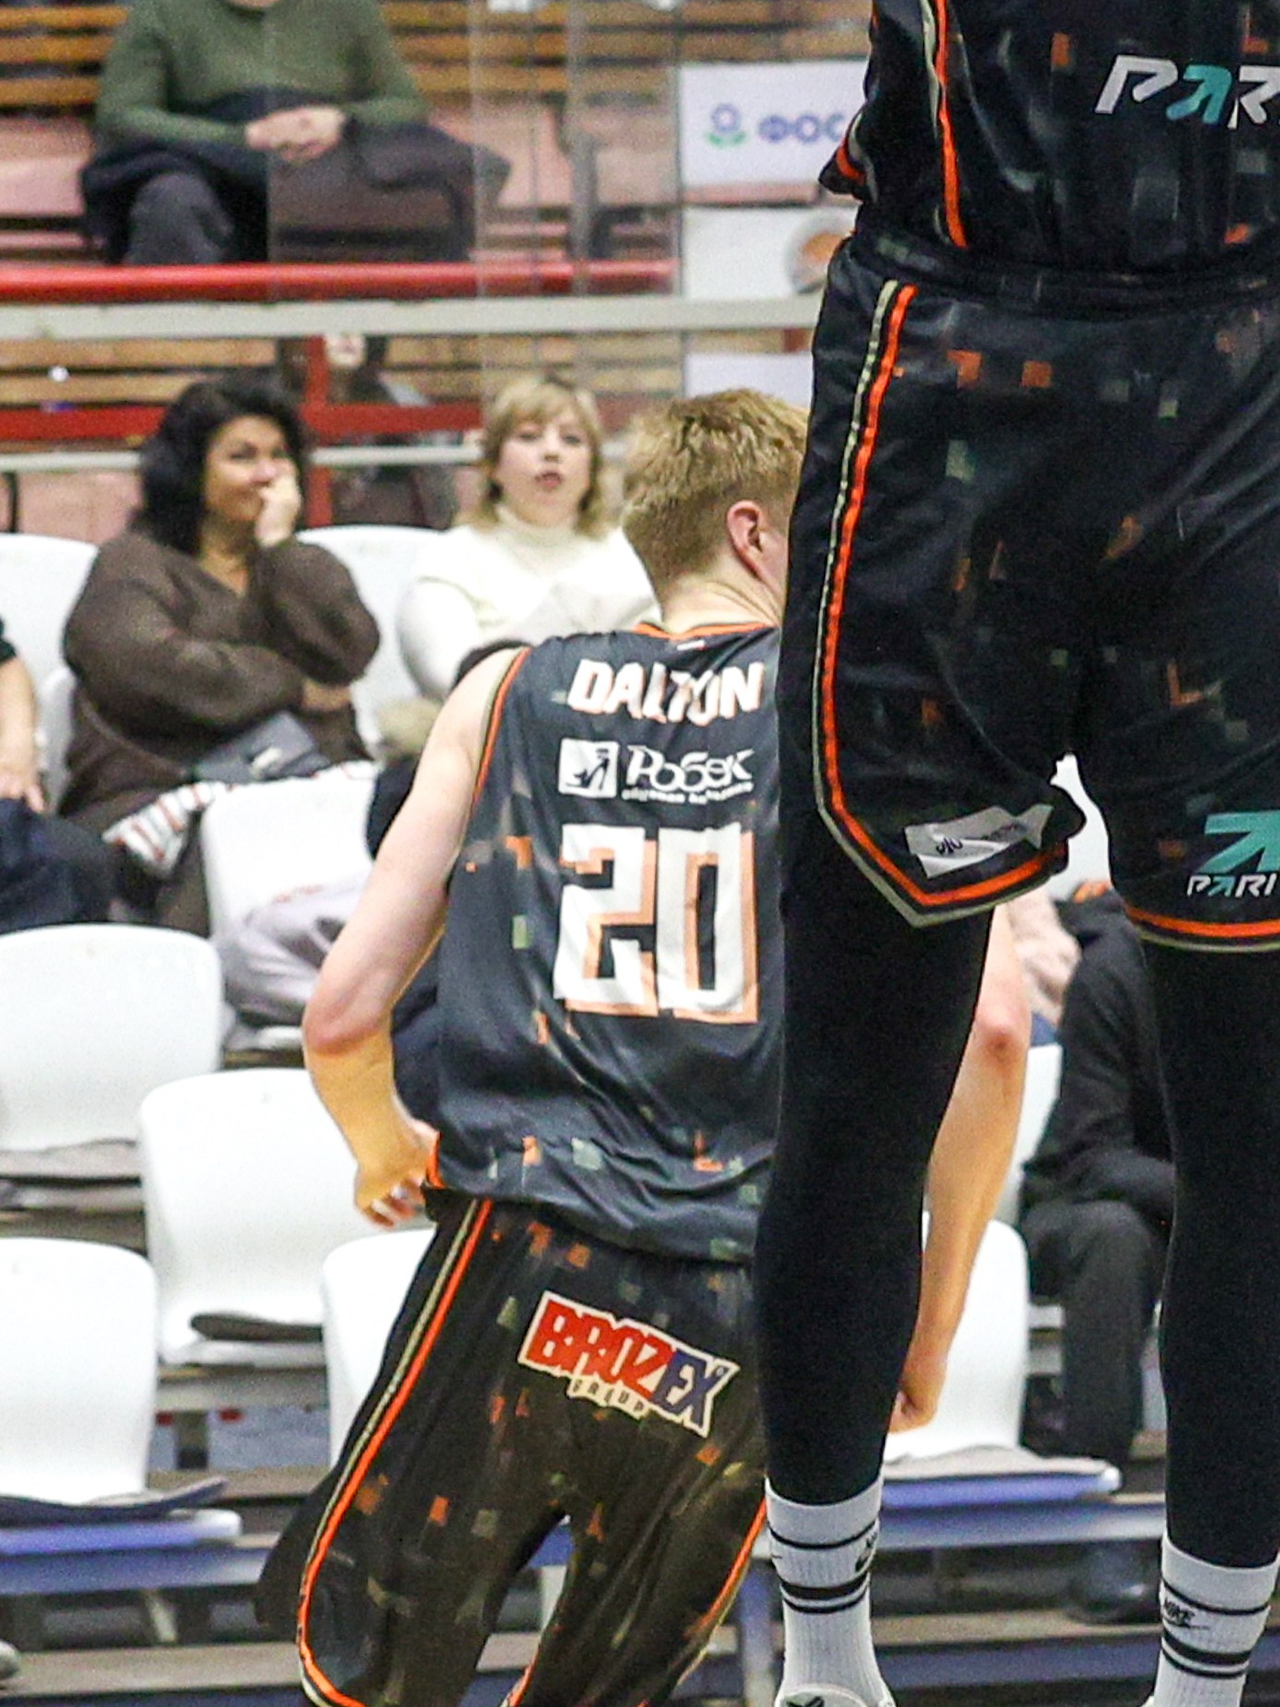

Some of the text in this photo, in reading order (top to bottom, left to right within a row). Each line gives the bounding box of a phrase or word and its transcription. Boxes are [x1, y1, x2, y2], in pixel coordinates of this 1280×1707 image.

[567, 658, 765, 727] DALTON
[553, 821, 760, 1025] 20
[1186, 872, 1278, 898] PARI
[519, 1290, 740, 1438] BROZEX
